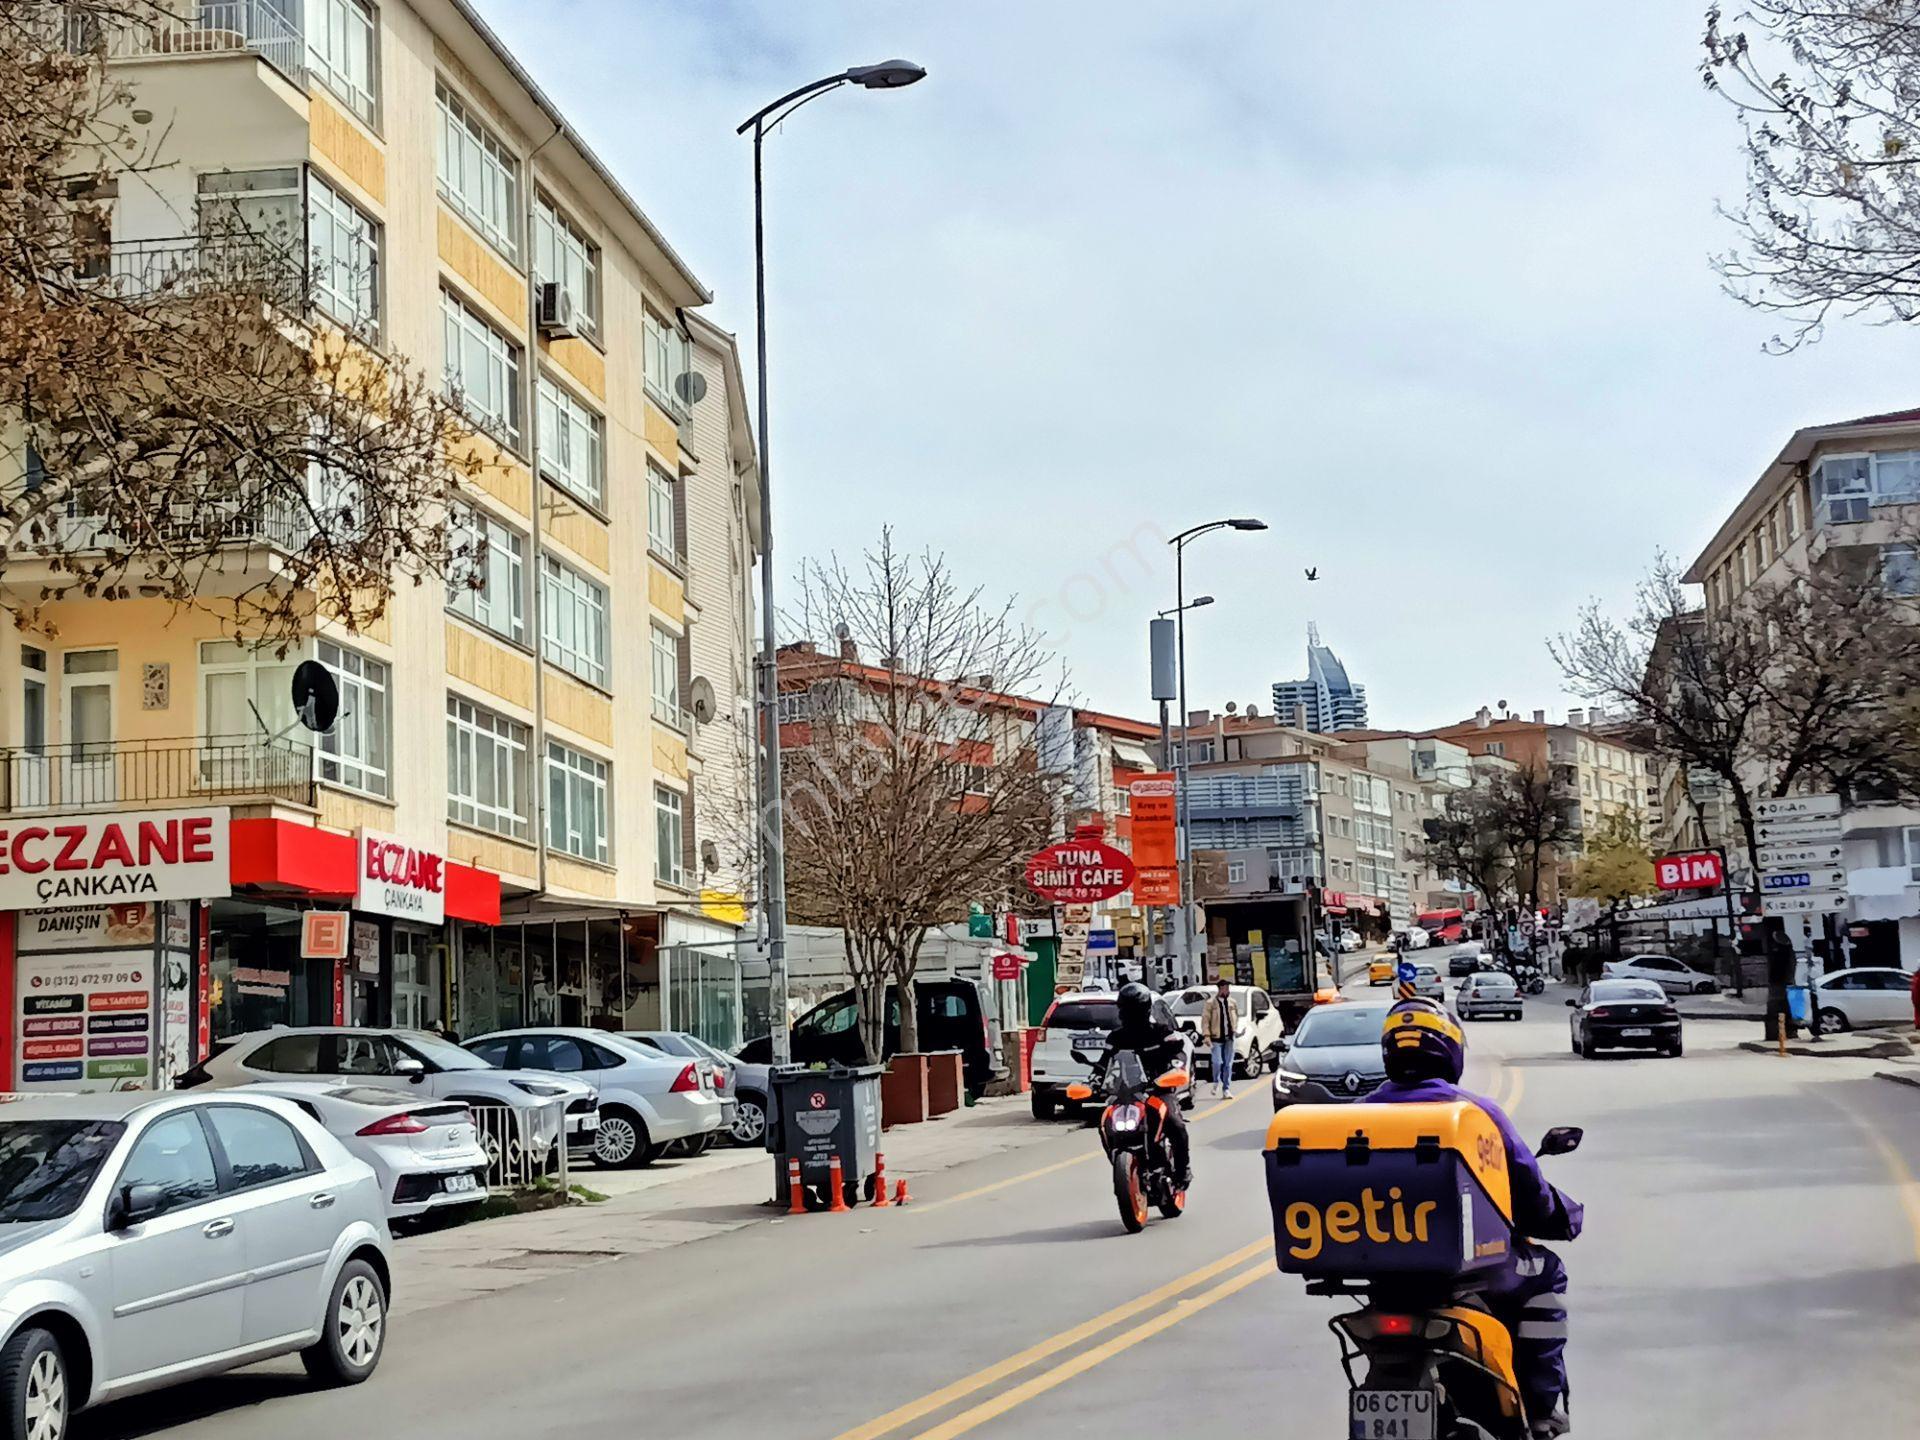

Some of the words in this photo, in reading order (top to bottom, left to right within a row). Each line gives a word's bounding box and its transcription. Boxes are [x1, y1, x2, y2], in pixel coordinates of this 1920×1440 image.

[366, 837, 443, 893] ECZANE
[1055, 850, 1103, 865] TUNA
[1761, 852, 1816, 863] Dikmen
[1033, 867, 1078, 886] SİMİT
[1081, 869, 1124, 886] CAFE
[1661, 856, 1717, 884] BİM
[36, 873, 158, 903] ÇANKAYA
[1763, 874, 1809, 887] Konya
[384, 888, 424, 912] ÇANKAYA
[38, 914, 101, 934] DANIŞIN
[126, 910, 139, 924] E
[313, 920, 335, 948] E
[54, 974, 79, 987] (312)
[82, 973, 99, 984] 472
[102, 973, 113, 983] 97
[117, 972, 129, 983] 09
[199, 937, 208, 1056] ECZAN
[1285, 1187, 1437, 1260] getir
[1356, 1393, 1380, 1413] 06
[1385, 1393, 1429, 1413] CTU
[1373, 1419, 1409, 1438] 841
